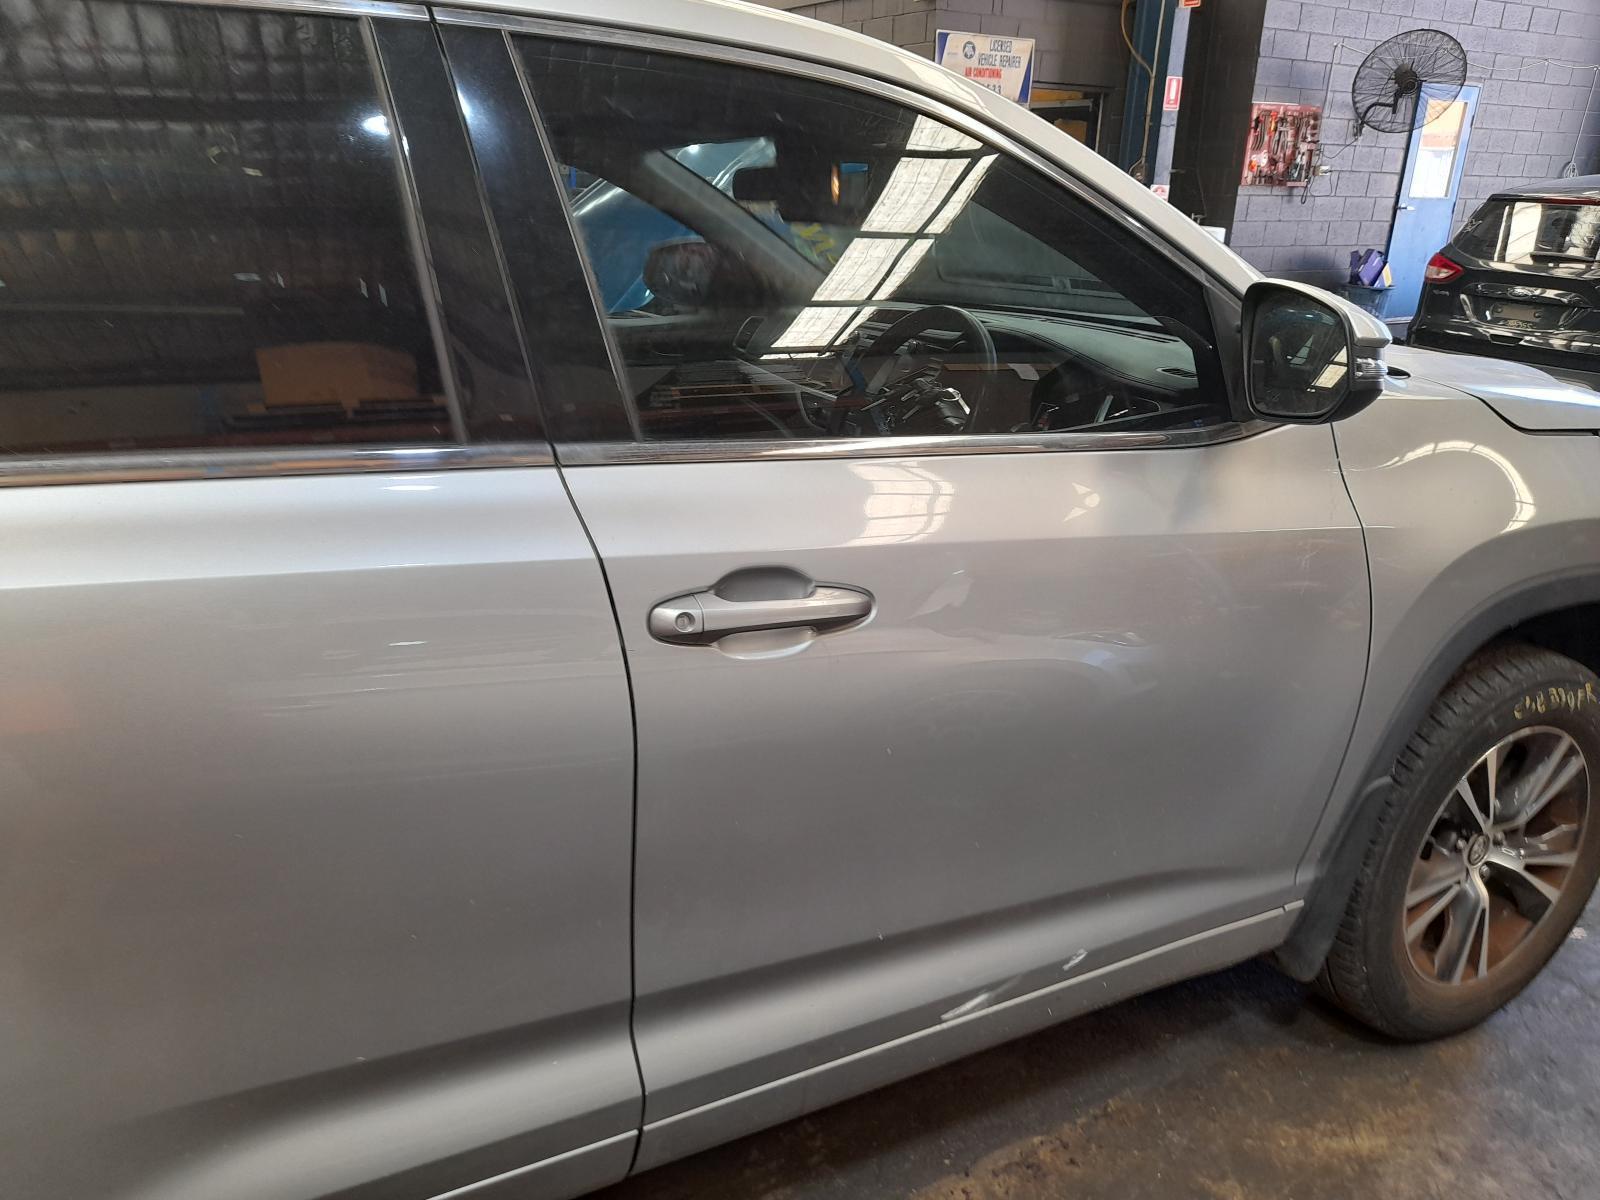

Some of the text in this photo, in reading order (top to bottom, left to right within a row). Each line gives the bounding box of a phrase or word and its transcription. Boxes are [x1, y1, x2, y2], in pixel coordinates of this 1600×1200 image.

[990, 39, 1013, 53] LICENSED
[978, 53, 1021, 67] VEHICLE REPAIRER
[973, 67, 1001, 78] CONDITIONING
